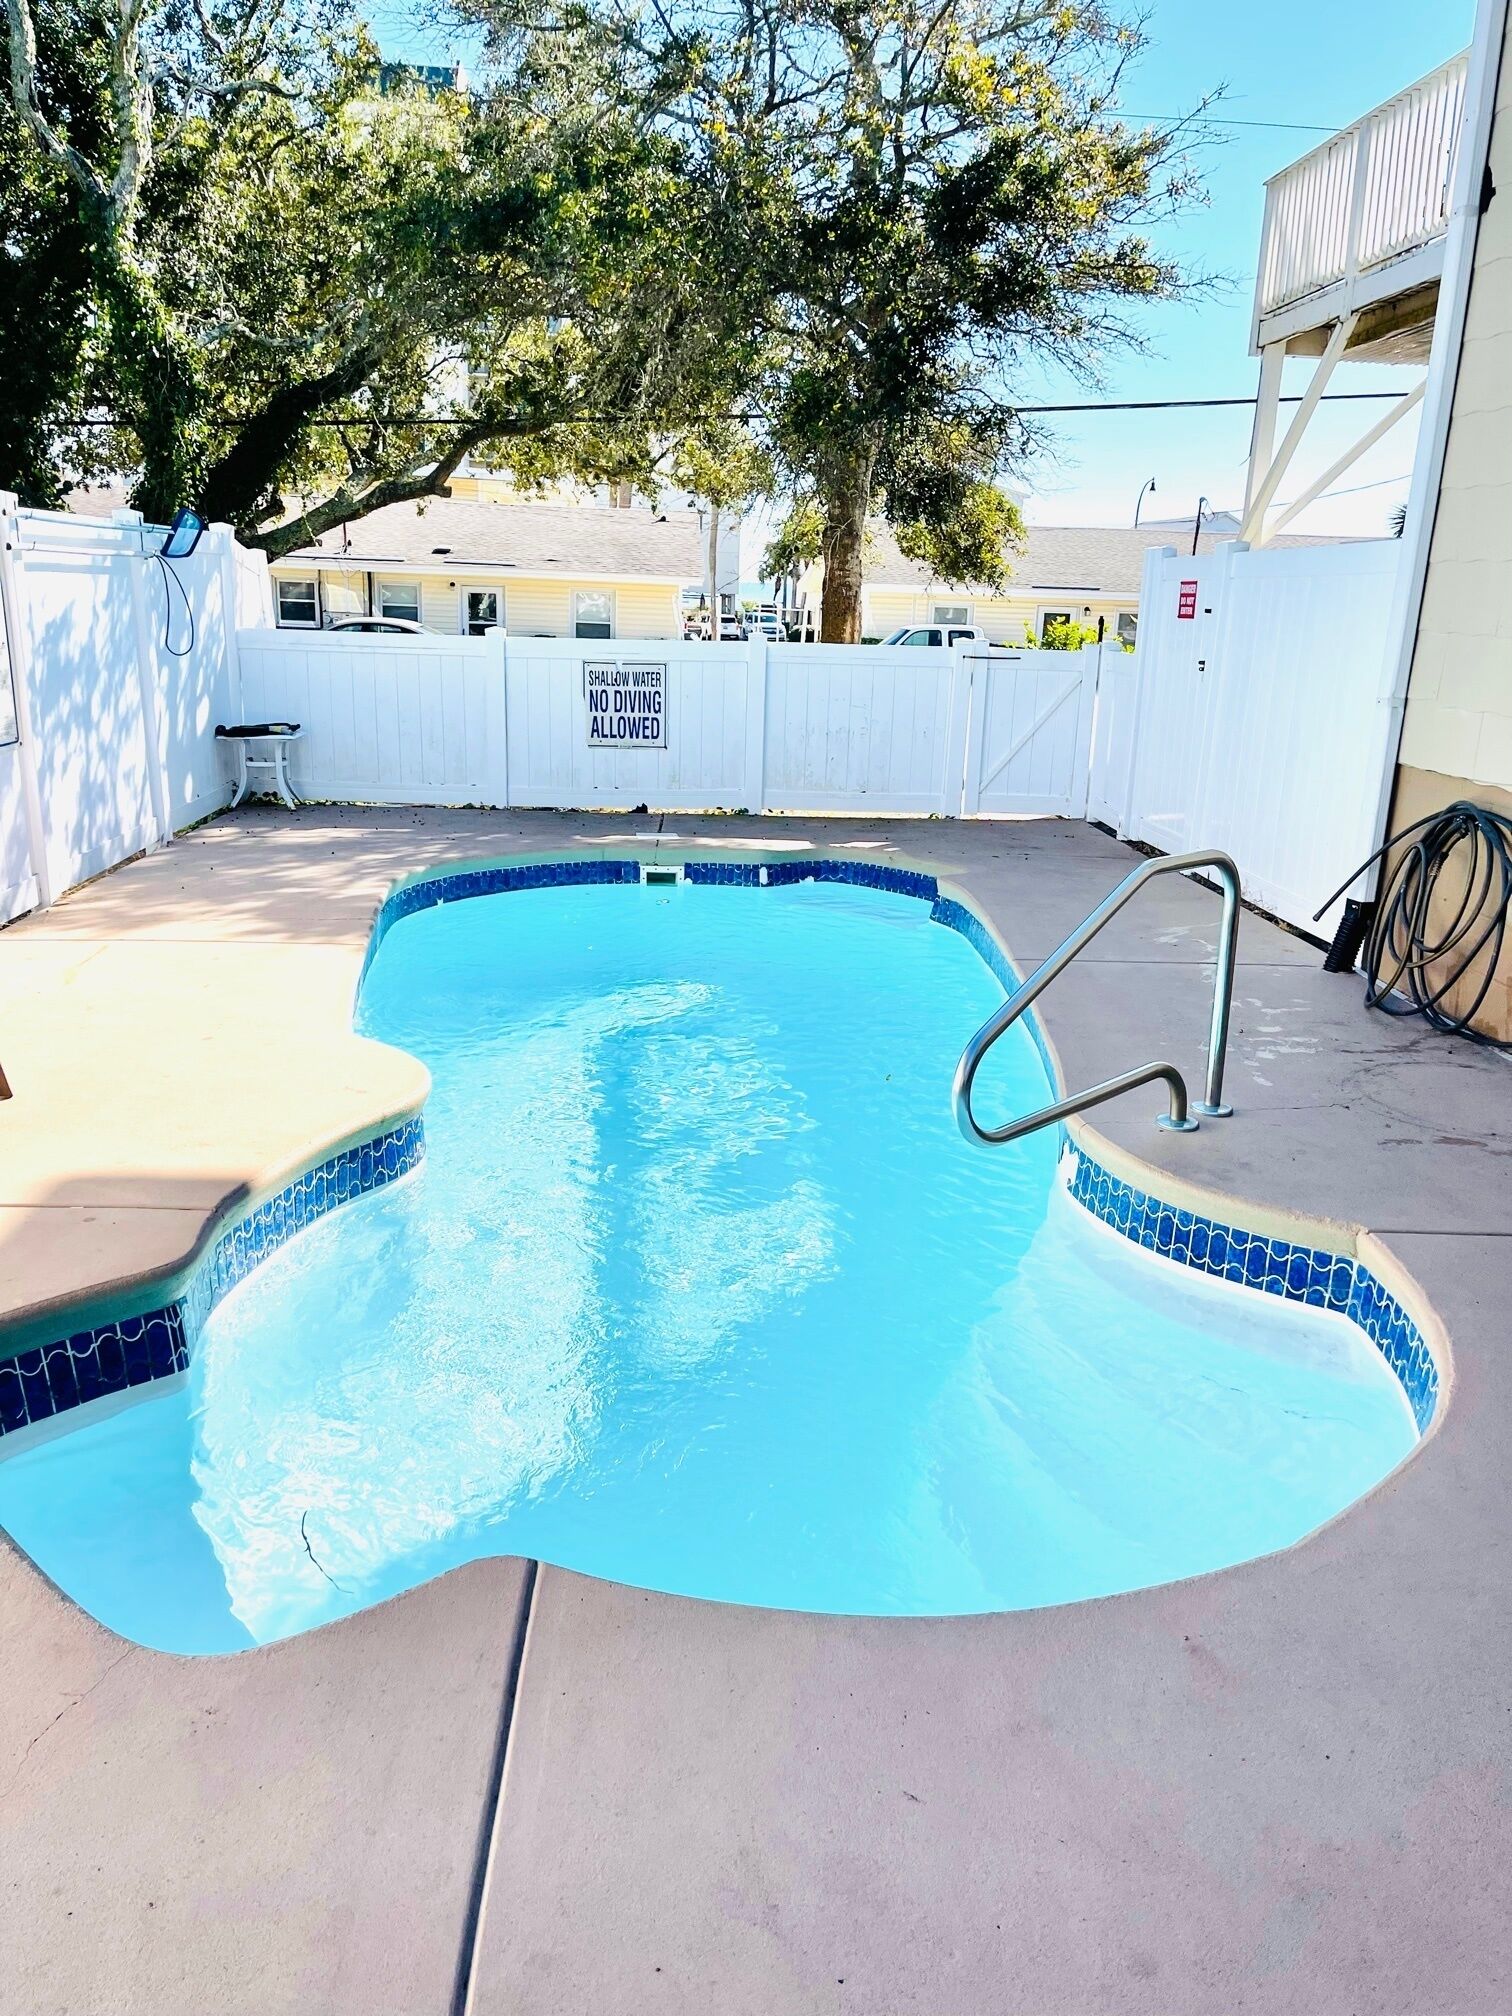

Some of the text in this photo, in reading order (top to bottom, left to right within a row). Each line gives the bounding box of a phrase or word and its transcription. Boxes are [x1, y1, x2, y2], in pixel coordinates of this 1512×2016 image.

[588, 670, 662, 688] SHALLOW WATER
[589, 689, 662, 714] NO DIVING
[590, 715, 660, 739] ALLOWED
